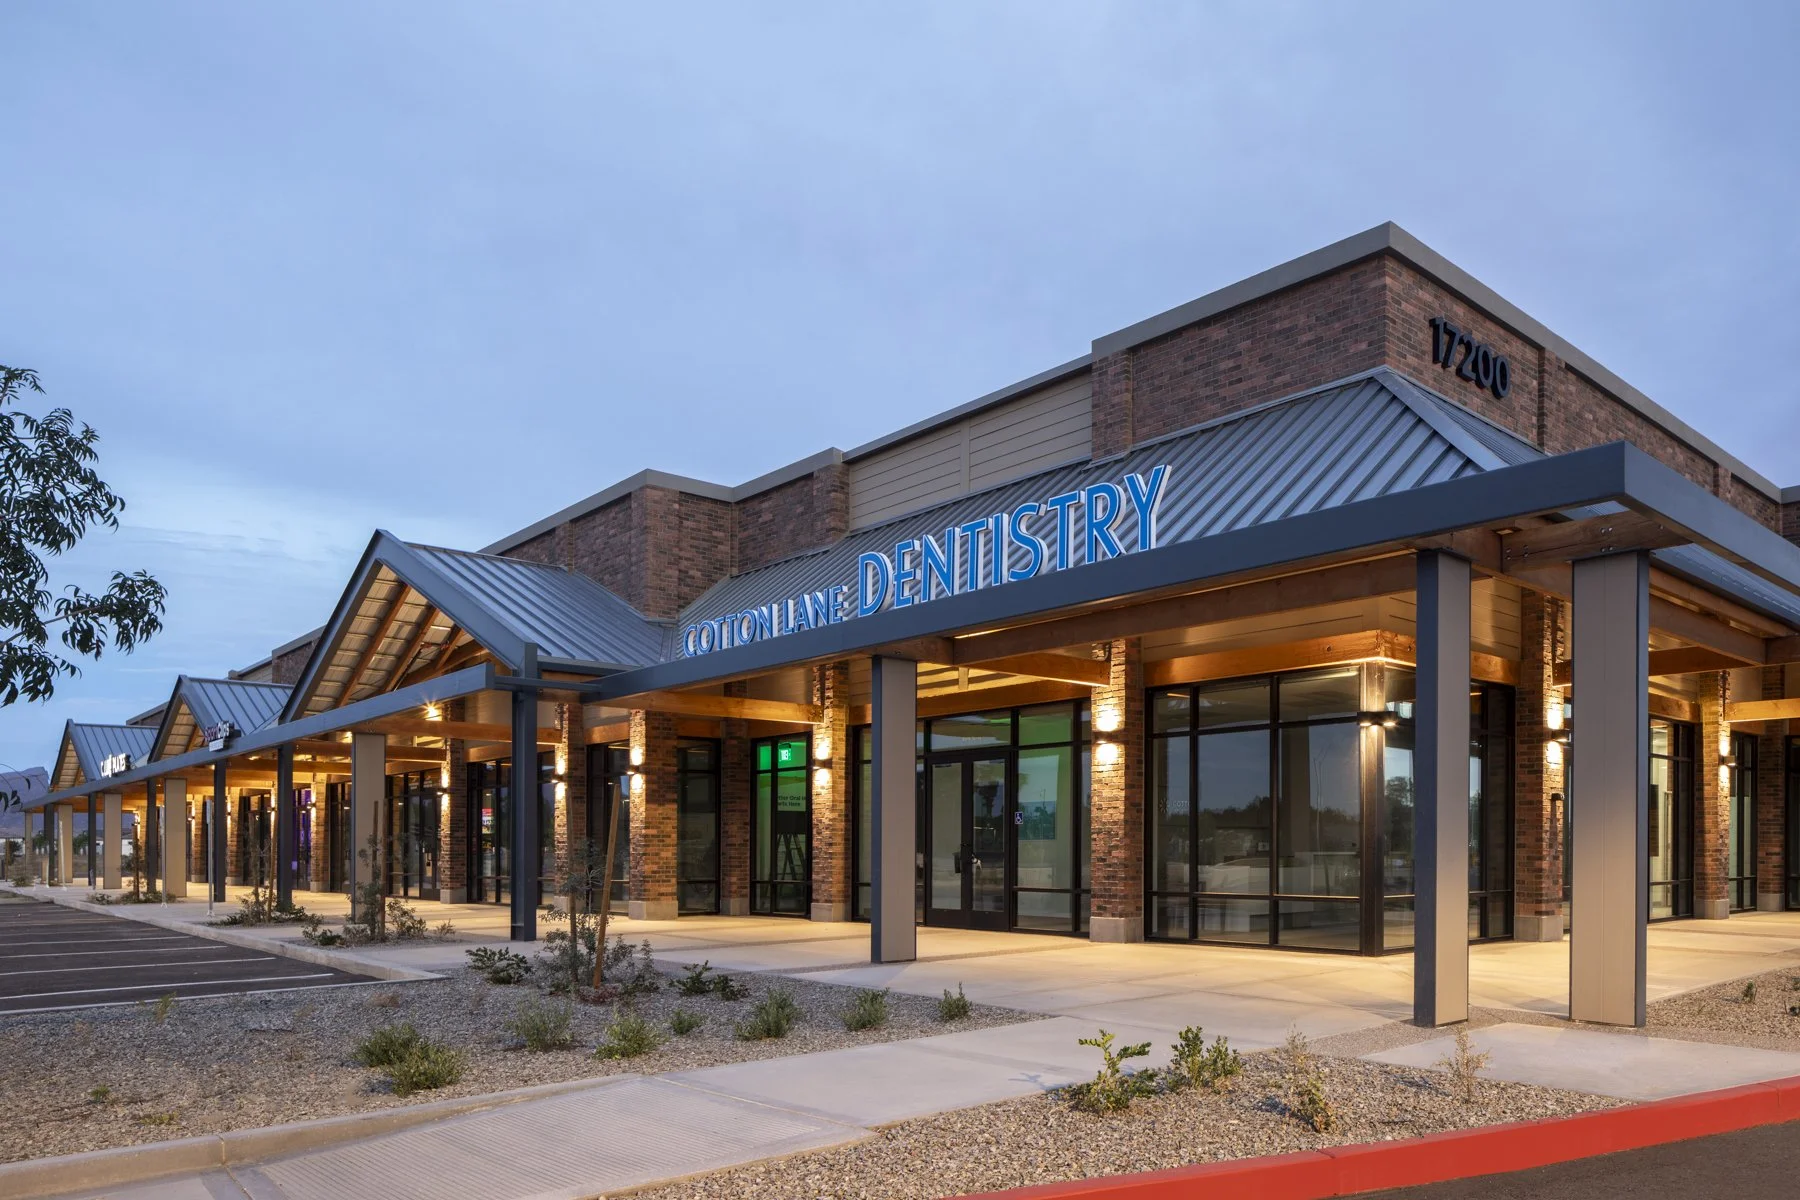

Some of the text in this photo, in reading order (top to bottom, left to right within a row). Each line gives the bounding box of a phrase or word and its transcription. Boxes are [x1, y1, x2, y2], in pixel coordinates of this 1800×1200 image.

[1429, 316, 1511, 400] 17200
[683, 464, 1172, 658] COTTON LANE DENTISTRY
